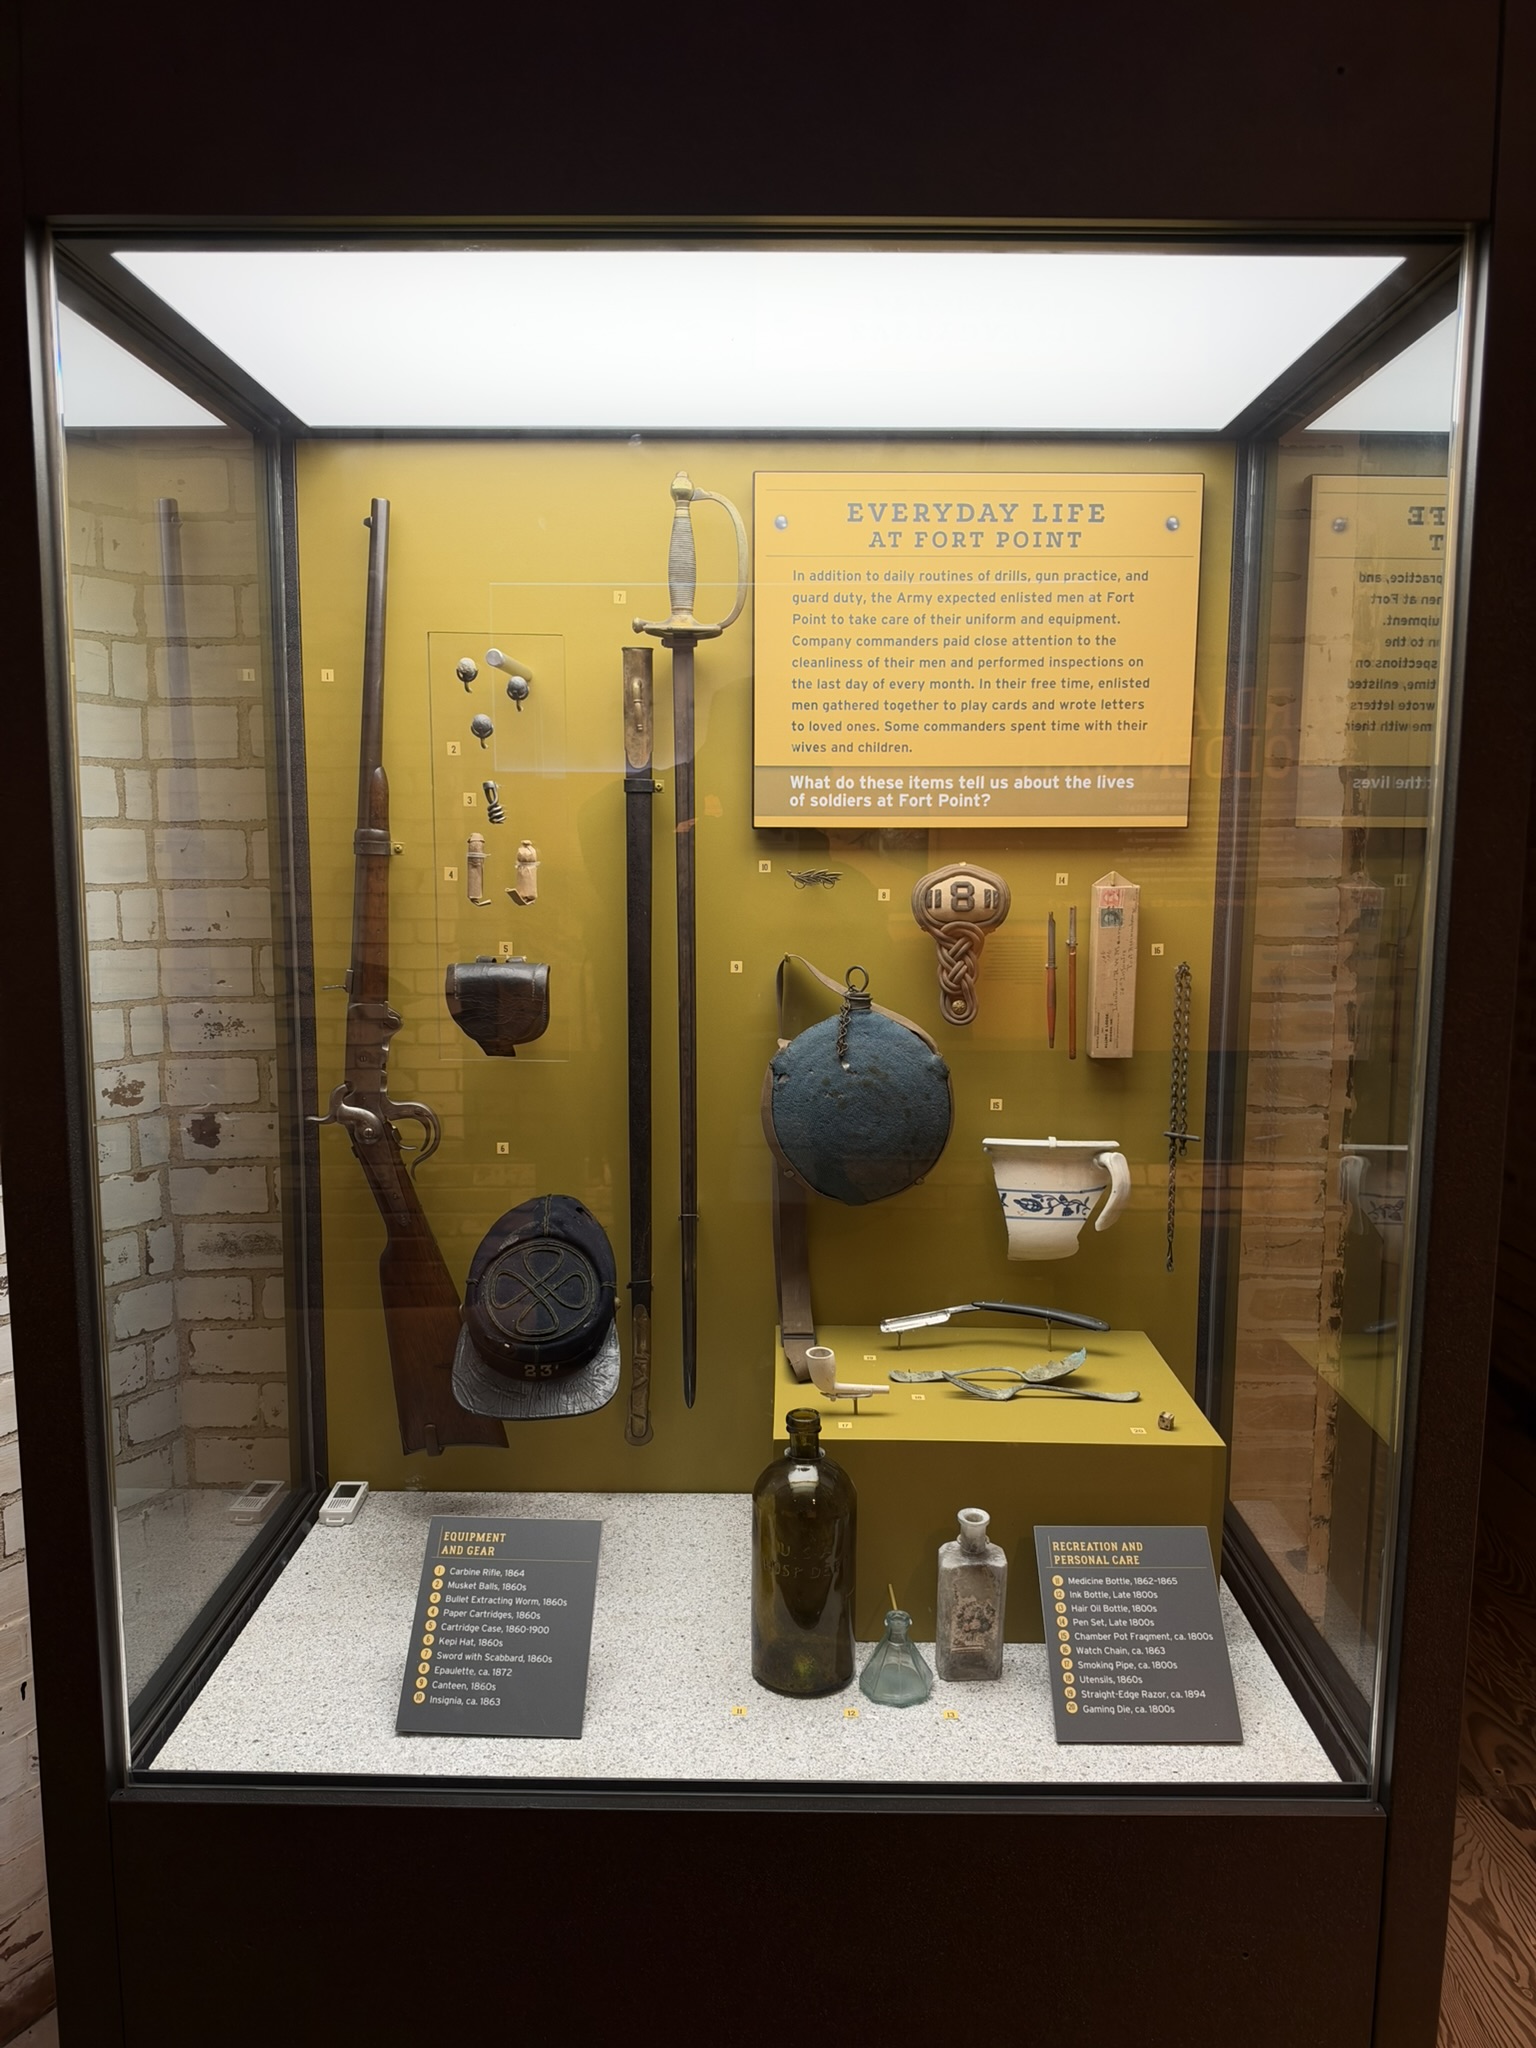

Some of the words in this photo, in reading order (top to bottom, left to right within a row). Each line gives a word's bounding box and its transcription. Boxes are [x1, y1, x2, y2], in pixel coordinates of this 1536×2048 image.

[847, 503, 1018, 522] EVERYDAY
[1032, 503, 1104, 522] LIFE
[868, 532, 902, 547] AT
[914, 531, 983, 548] FORT
[996, 531, 1081, 548] POINT
[793, 570, 804, 580] In
[809, 570, 861, 581] addition
[866, 570, 879, 581] to
[884, 570, 914, 583] daily
[919, 570, 972, 581] routines
[978, 570, 990, 581] of
[994, 570, 1030, 581] drills,
[1035, 572, 1058, 583] gun
[1064, 570, 1120, 582] practice,
[1125, 570, 1148, 581] and
[792, 592, 828, 605] guard
[833, 592, 866, 605] duty,
[871, 592, 892, 603] the
[896, 592, 932, 605] Army
[937, 592, 995, 604] expected
[1000, 592, 1052, 602] enlisted
[1057, 594, 1083, 602] men
[1088, 592, 1101, 602] at
[1107, 592, 1134, 602] Fort
[792, 678, 812, 689] the
[817, 678, 840, 689] last
[845, 679, 868, 691] day
[872, 678, 884, 689] of
[889, 681, 924, 691] every
[930, 678, 974, 689] month.
[980, 678, 990, 688] In
[995, 678, 1026, 688] their
[1031, 678, 1056, 688] free
[1061, 678, 1093, 689] time,
[1098, 678, 1149, 688] enlisted
[791, 721, 804, 731] to
[809, 721, 841, 731] loved
[846, 723, 879, 731] ones.
[884, 721, 919, 731] Some
[924, 721, 1005, 731] commanders
[1010, 721, 1046, 733] spent
[1051, 720, 1079, 731] time
[1084, 720, 1111, 730] with
[1117, 720, 1147, 730] their
[791, 742, 826, 752] wives
[831, 742, 853, 752] and
[858, 742, 912, 752] children.
[790, 775, 830, 788] What
[836, 776, 854, 788] do
[859, 776, 903, 789] these
[909, 775, 953, 789] items
[958, 775, 984, 788] tell
[990, 778, 1008, 788] us
[1014, 775, 1059, 788] about
[1064, 775, 1091, 788] the
[1097, 775, 1134, 788] lives
[790, 793, 804, 806] of
[810, 793, 871, 806] soldiers
[877, 794, 893, 806] at
[899, 794, 932, 806] Fort
[938, 793, 990, 806] Point?
[444, 1532, 505, 1542] EQUIPMENT
[441, 1545, 463, 1554] AND
[467, 1546, 494, 1555] GEAR
[1052, 1541, 1117, 1550] RECREATION
[1122, 1542, 1142, 1551] AND
[1054, 1555, 1109, 1564] PERSONAL
[1112, 1555, 1139, 1564] CARE
[450, 1567, 480, 1575] Carbine
[482, 1568, 502, 1576] Rifle,
[505, 1569, 524, 1577] 1864
[448, 1581, 476, 1589] Musket
[478, 1582, 499, 1590] Balls,
[502, 1583, 526, 1591] 1860s
[1105, 1577, 1132, 1585] Bottle,
[1083, 1590, 1110, 1598] Bottle,
[471, 1596, 512, 1606] Extracting
[515, 1597, 540, 1606] Worm,
[543, 1598, 567, 1606] 1860s
[1090, 1604, 1101, 1612] Oil
[1103, 1604, 1130, 1612] Bottle,
[1131, 1604, 1157, 1612] 1800s
[443, 1609, 467, 1617] Paper
[469, 1610, 513, 1619] Cartridges,
[516, 1611, 540, 1619] 1860s
[1072, 1618, 1088, 1626] Pen
[1090, 1618, 1106, 1626] Set,
[1108, 1618, 1127, 1626] Late
[1129, 1618, 1154, 1626] 1800s
[441, 1623, 479, 1632] Cartridge
[481, 1624, 503, 1633] Case,
[506, 1625, 549, 1634] 1860-1900
[1074, 1632, 1110, 1640] Chamber
[1113, 1632, 1127, 1640] Pot
[1187, 1632, 1213, 1640] 1800s
[439, 1637, 457, 1646] Kepi
[459, 1638, 475, 1646] Hat,
[478, 1638, 503, 1646] 1860s
[1104, 1646, 1129, 1655] Chain,
[1145, 1646, 1165, 1654] 1863
[437, 1651, 462, 1660] Sword
[484, 1653, 524, 1662] Scabbard,
[528, 1654, 552, 1663] 1860s
[1077, 1661, 1113, 1670] Smoking
[1115, 1661, 1136, 1670] Pipe,
[1151, 1661, 1177, 1669] 1800s
[434, 1666, 475, 1675] Epaulette,
[492, 1668, 512, 1676] 1872
[1079, 1676, 1115, 1684] Utensils,
[1117, 1675, 1142, 1683] 1860s
[432, 1680, 468, 1690] Canteen,
[471, 1682, 496, 1690] 1860s
[1081, 1690, 1139, 1699] Straight-Edge
[1141, 1690, 1168, 1698] Razor,
[1184, 1690, 1205, 1698] 1894
[430, 1696, 463, 1705] Insignia,
[480, 1697, 500, 1706] 1863
[1082, 1705, 1114, 1714] Gaming
[1117, 1705, 1132, 1713] Die,
[1148, 1705, 1175, 1713] 1800s
